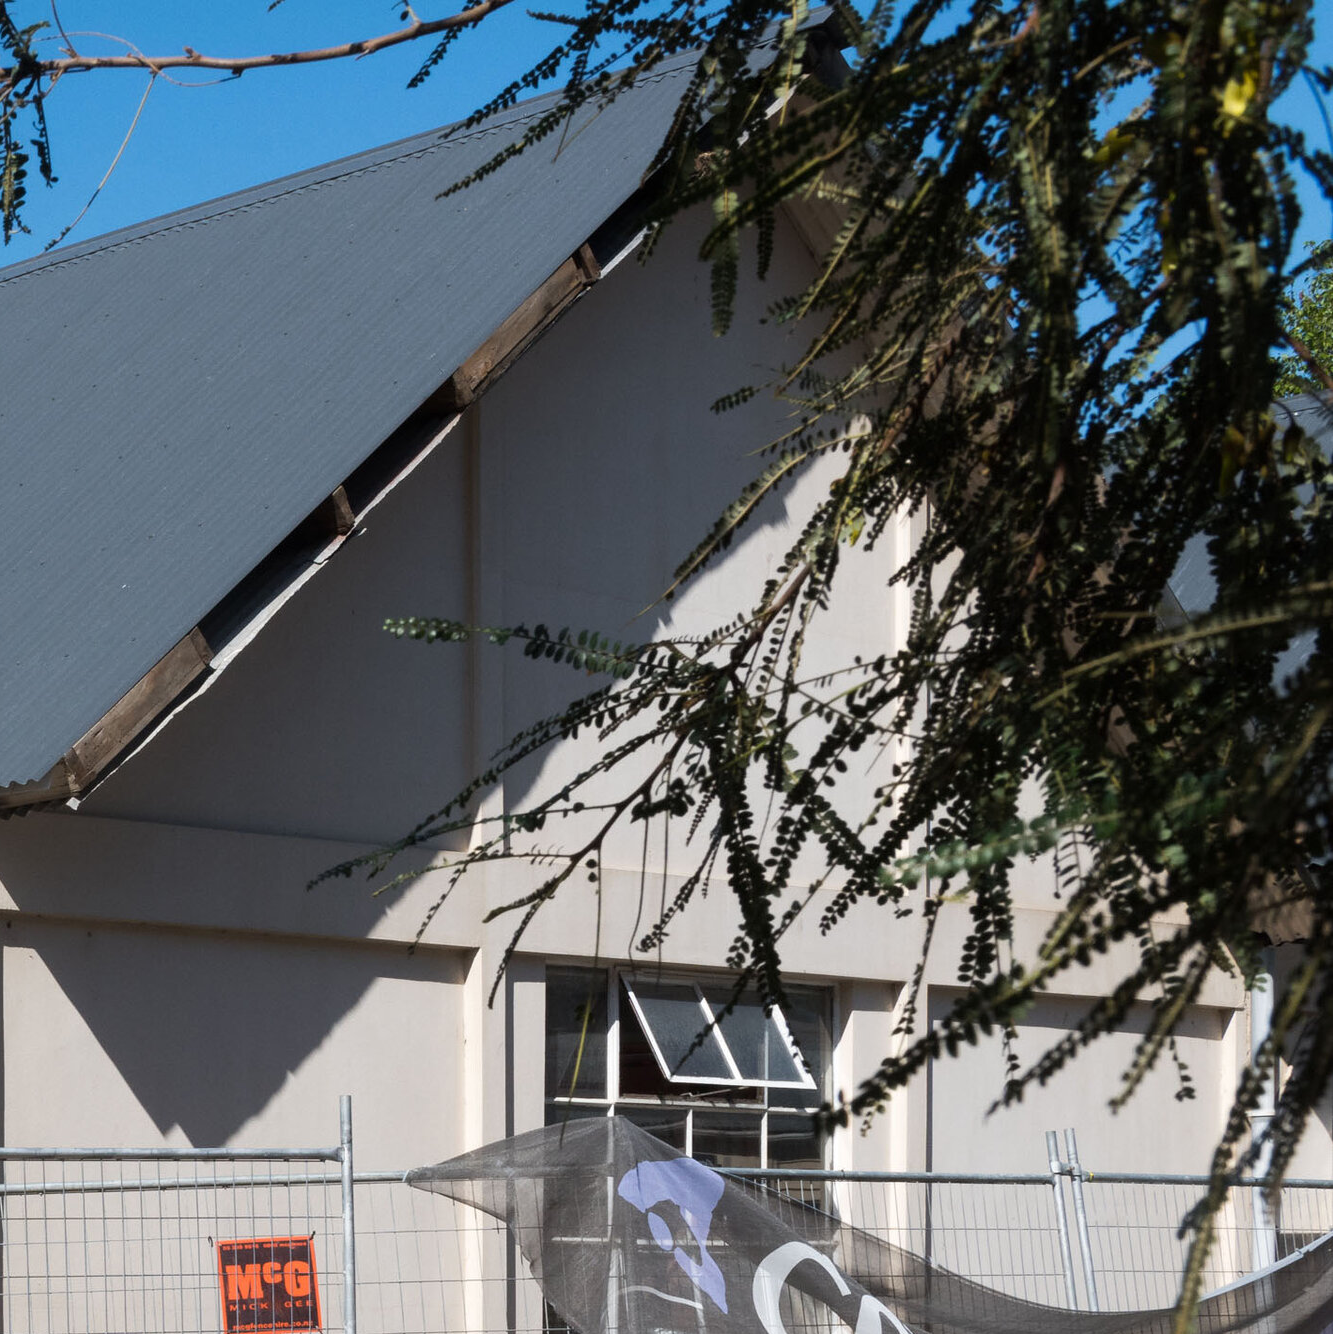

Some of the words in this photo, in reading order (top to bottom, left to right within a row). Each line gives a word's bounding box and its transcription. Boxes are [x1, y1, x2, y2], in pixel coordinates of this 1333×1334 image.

[225, 1260, 310, 1300] McG
[229, 1302, 268, 1311] MICK
[284, 1300, 314, 1308] GEE
